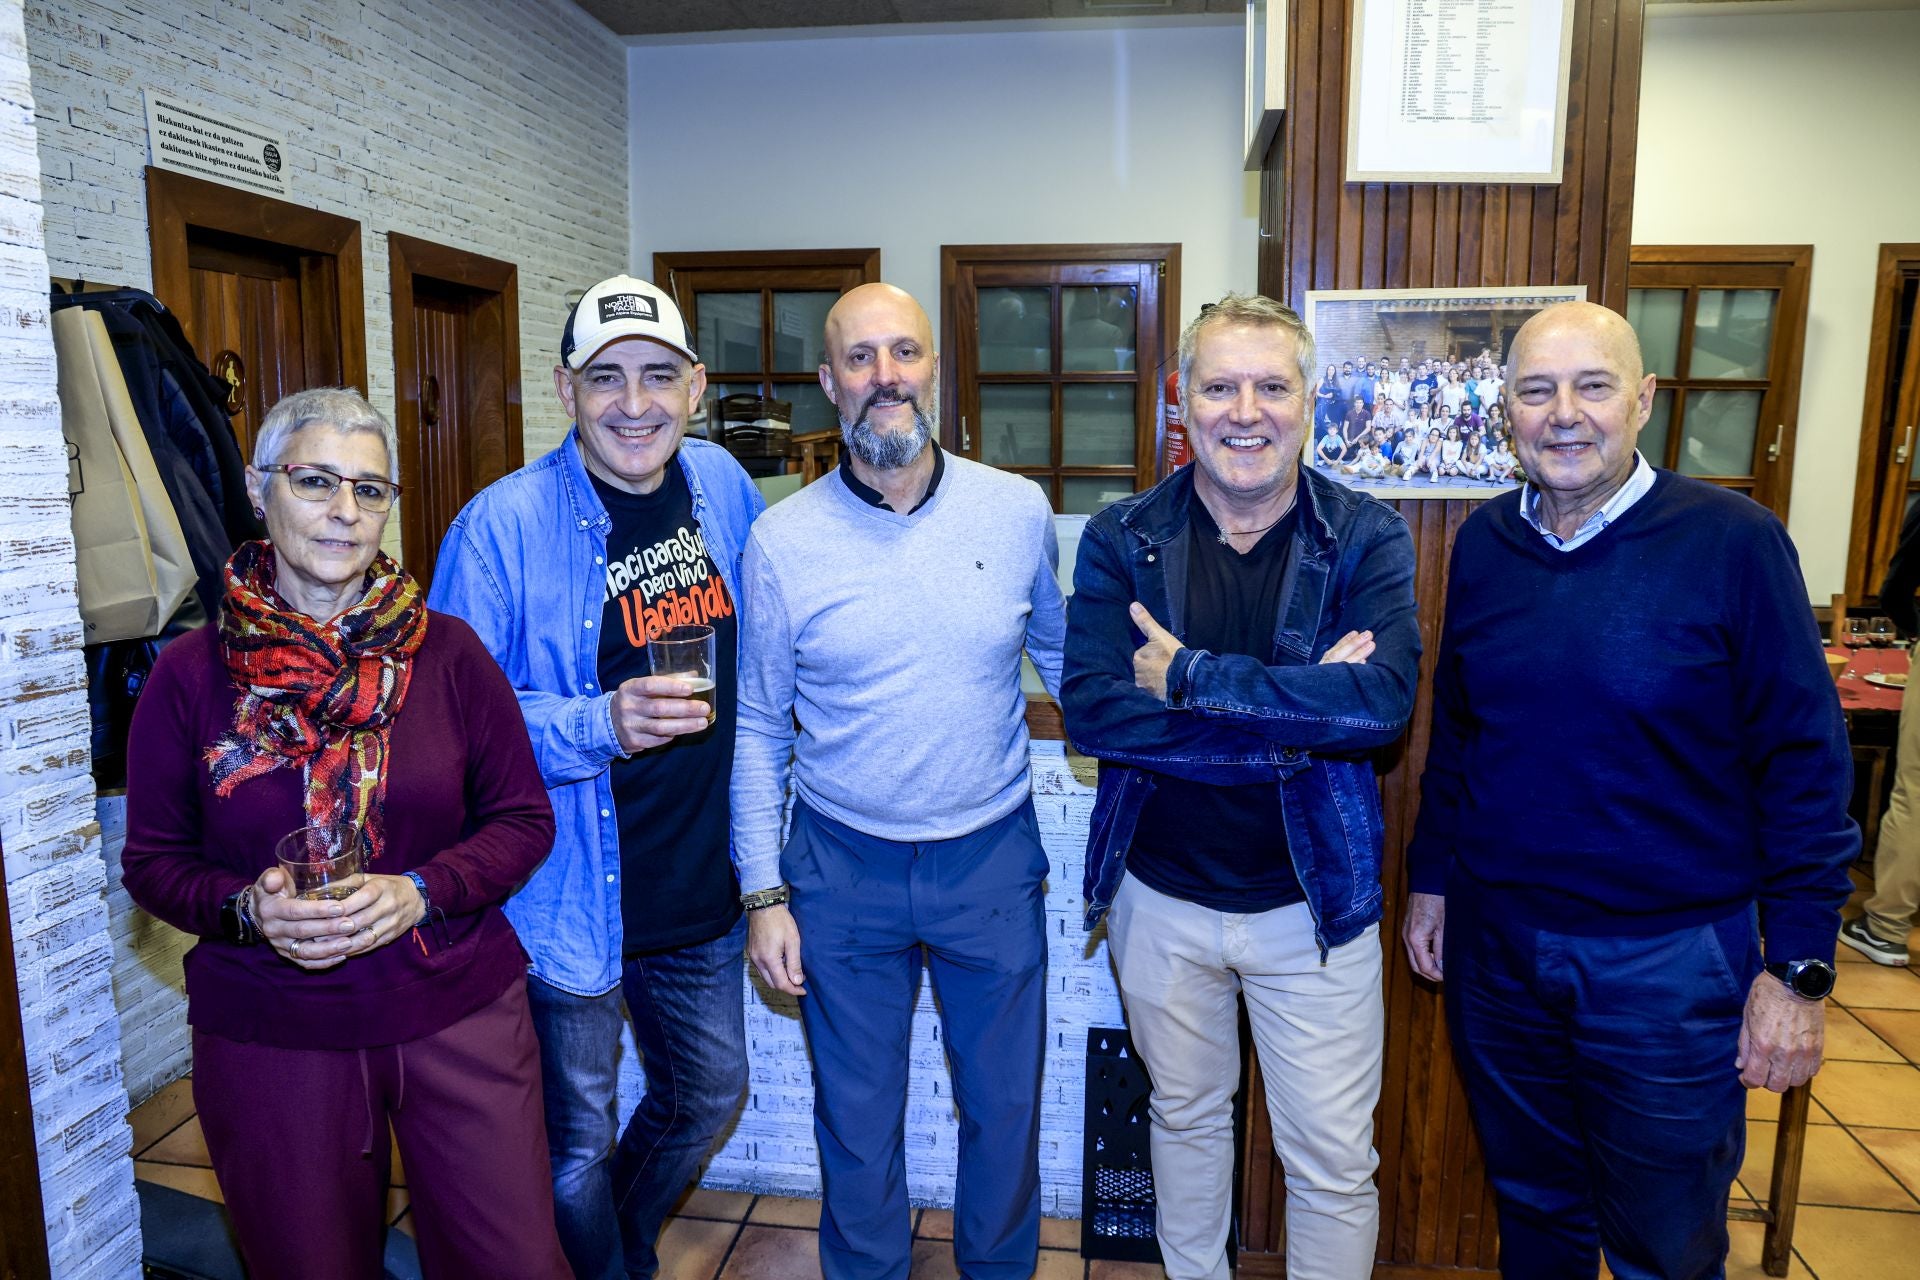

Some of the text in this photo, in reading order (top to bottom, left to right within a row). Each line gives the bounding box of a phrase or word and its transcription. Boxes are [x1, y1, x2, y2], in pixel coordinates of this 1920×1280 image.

[157, 113, 192, 132] Hizkuntza
[193, 125, 204, 136] bat
[212, 131, 221, 141] da
[221, 135, 244, 148] galtzen
[167, 130, 201, 147] dakitenek
[202, 140, 225, 153] ikasten
[160, 141, 194, 158] dakitenek
[194, 151, 208, 162] hitz
[208, 156, 229, 168] egiten
[236, 164, 263, 177] dutelako
[604, 300, 635, 310] NORTH
[642, 538, 684, 576] para
[639, 558, 708, 605] pero Vivo
[618, 574, 733, 648] Vacilando
